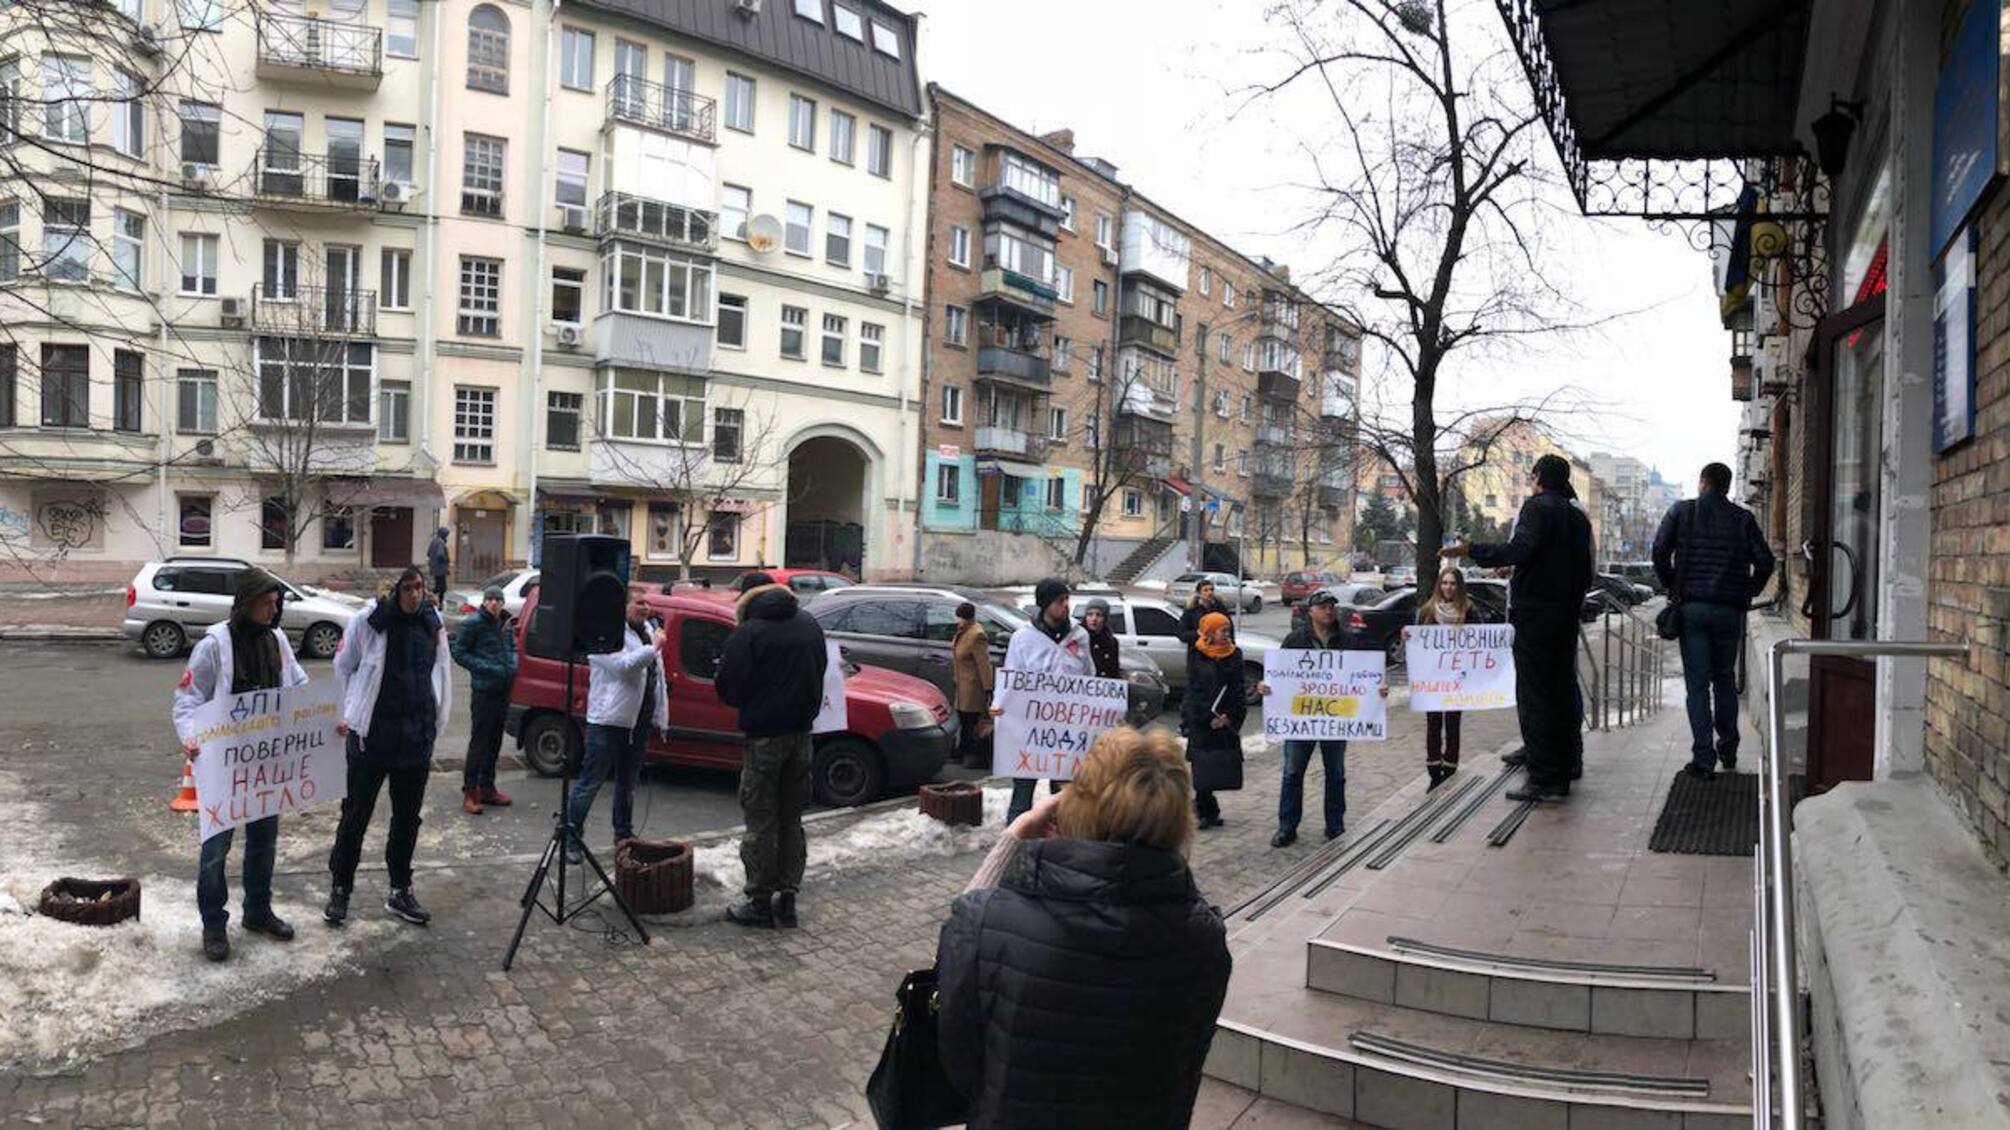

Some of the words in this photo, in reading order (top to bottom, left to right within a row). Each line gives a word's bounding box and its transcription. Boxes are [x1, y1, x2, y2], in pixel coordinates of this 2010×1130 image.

[1298, 650, 1343, 669] ДПІ
[1438, 650, 1496, 670] ГЕТЬ
[1300, 683, 1366, 696] ЗРОБИЛО
[230, 690, 282, 722] ДПІ
[1299, 699, 1339, 717] НАС
[224, 730, 326, 767] ПОВЕРНИ
[1026, 727, 1098, 751] ЛЮДЯ
[232, 753, 313, 797] НАШЕ
[205, 779, 316, 832] ЖИТЛО
